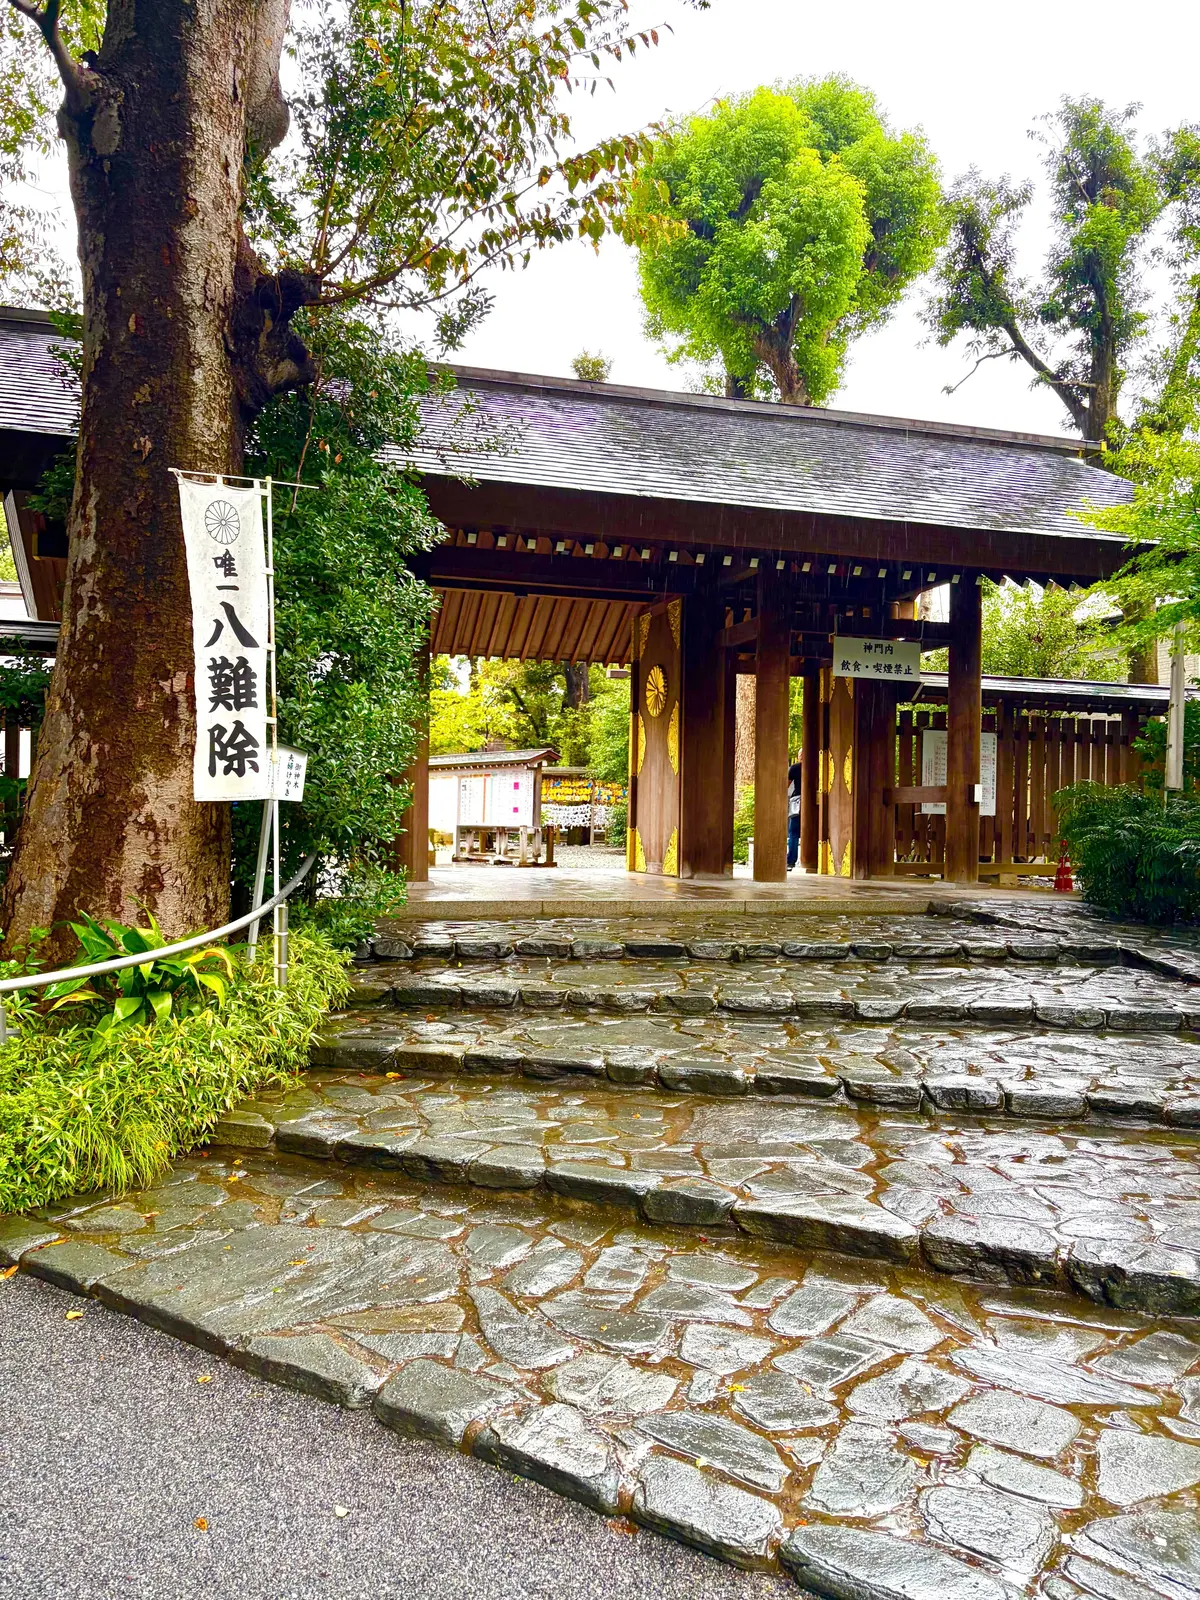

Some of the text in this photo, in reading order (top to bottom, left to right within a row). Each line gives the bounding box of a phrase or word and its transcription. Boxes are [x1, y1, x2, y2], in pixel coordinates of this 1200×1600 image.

[863, 642, 893, 655] 神門内
[204, 548, 260, 778] 唯一八難除
[841, 659, 914, 675] 飲食・喫煙禁止
